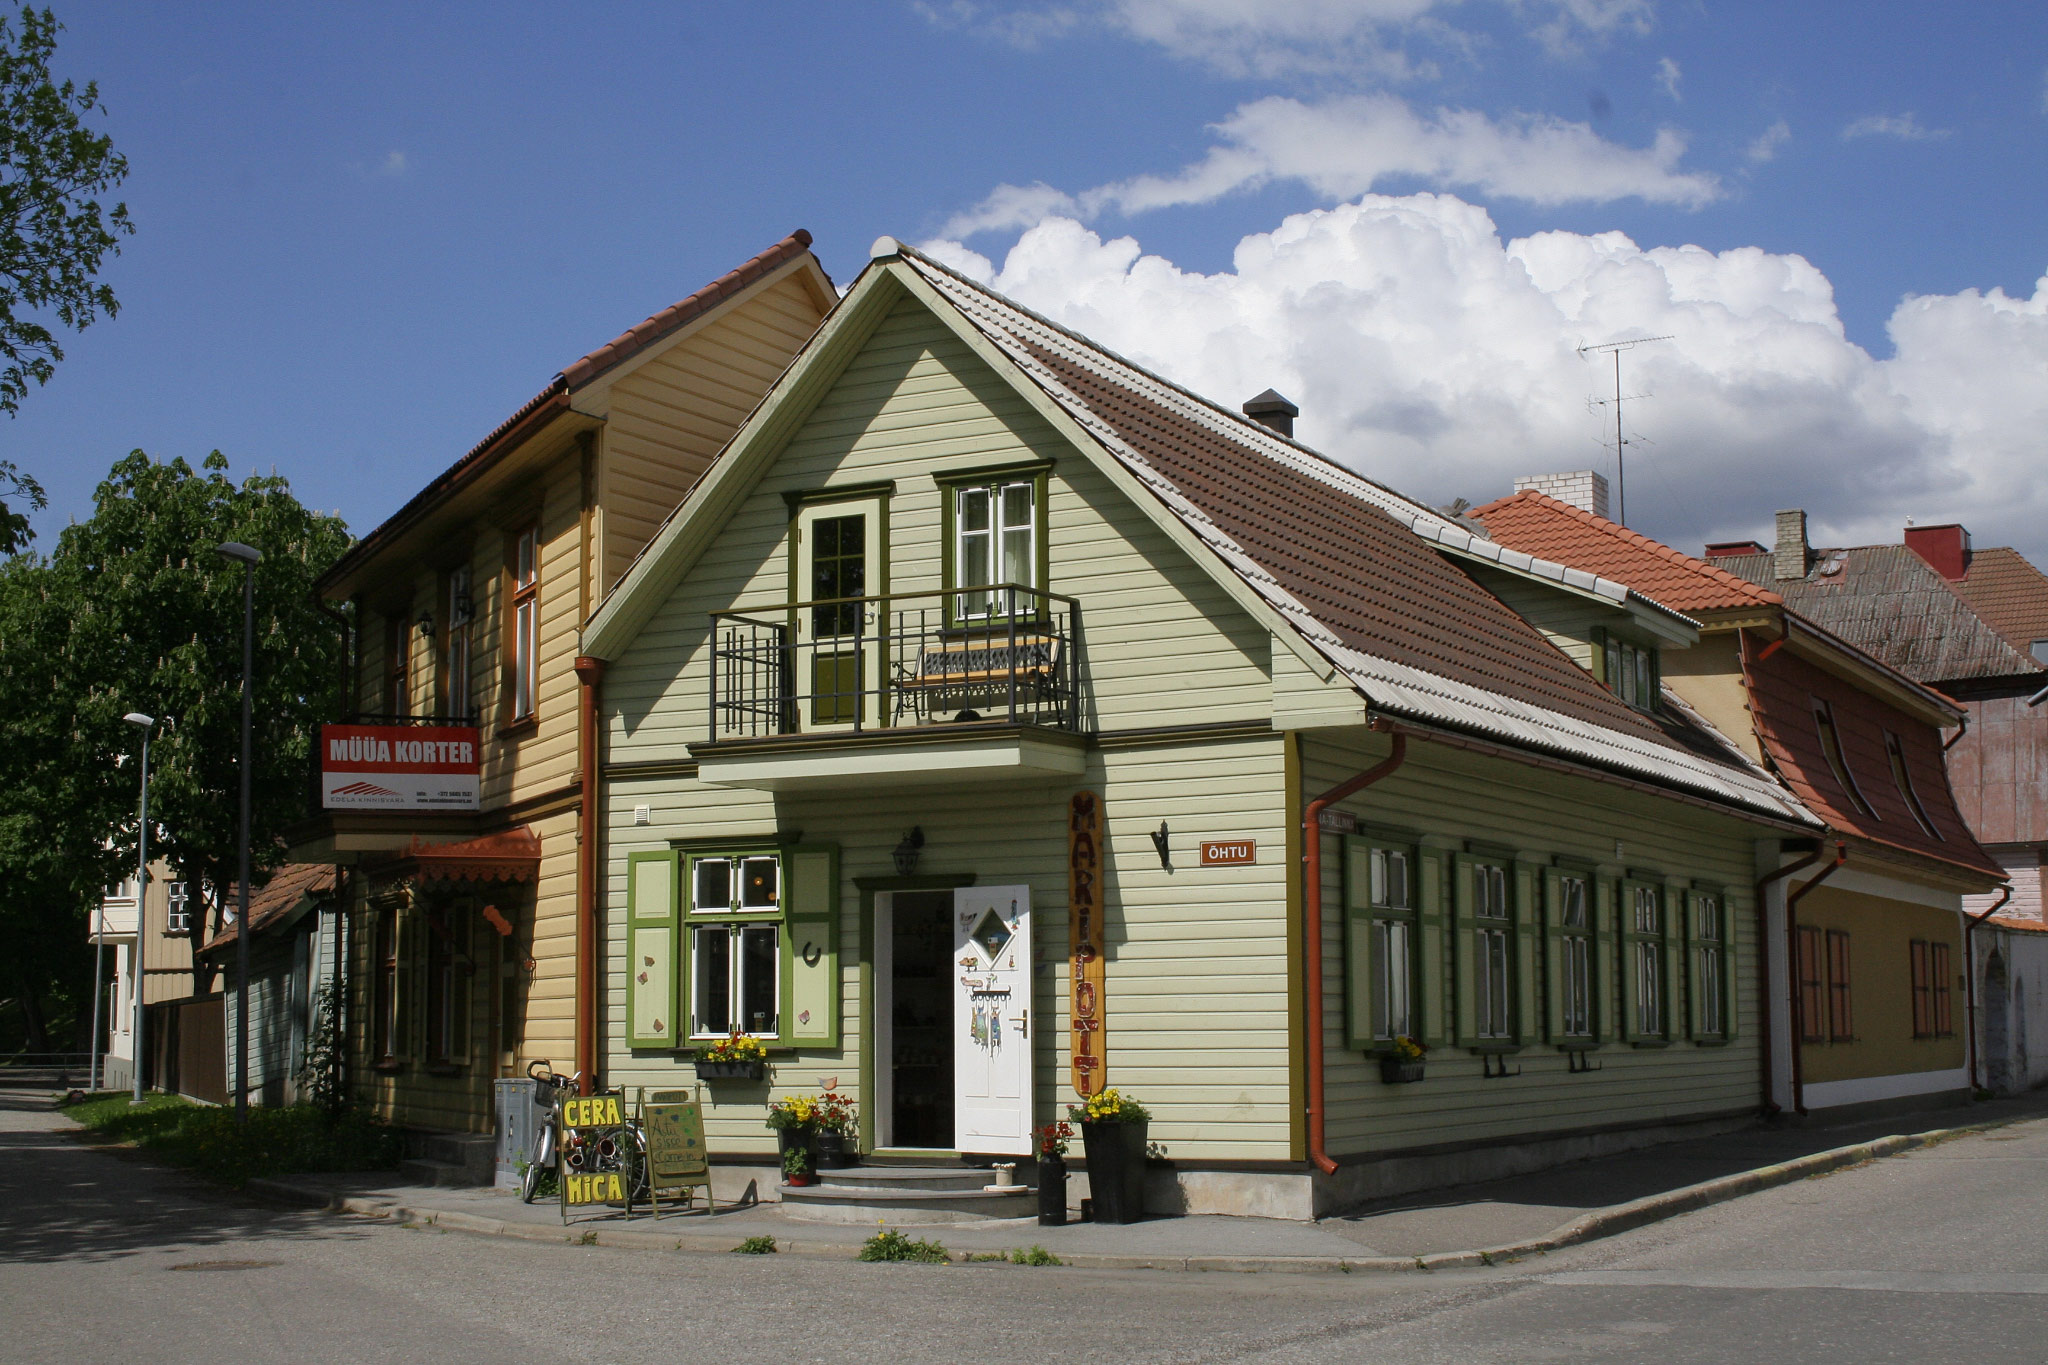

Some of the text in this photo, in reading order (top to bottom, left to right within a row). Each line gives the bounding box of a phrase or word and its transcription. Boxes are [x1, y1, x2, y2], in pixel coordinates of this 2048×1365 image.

[330, 736, 473, 763] MÜÜA KORTER
[1208, 845, 1247, 859] ÕHTU
[564, 1098, 621, 1127] CERA
